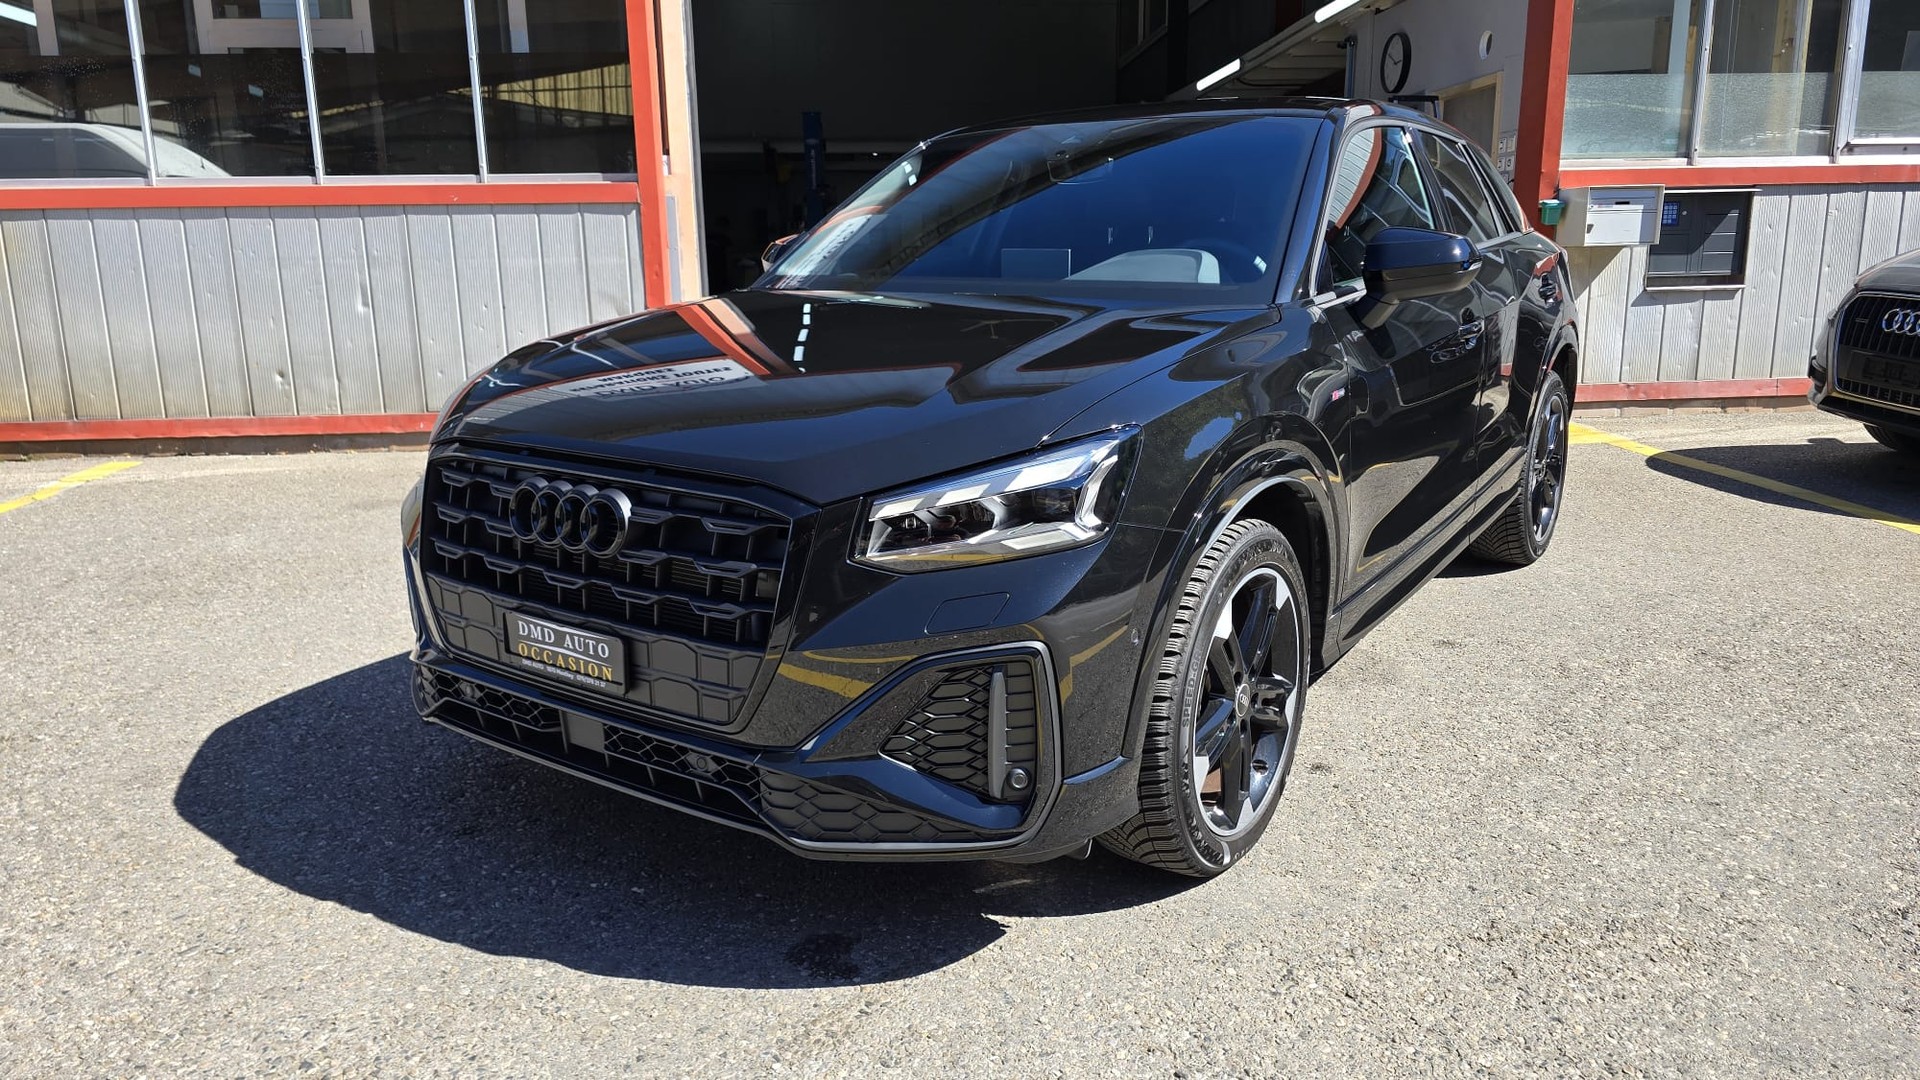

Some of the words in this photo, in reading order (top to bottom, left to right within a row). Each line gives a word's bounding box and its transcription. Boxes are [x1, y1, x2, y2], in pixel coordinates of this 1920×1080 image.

[518, 621, 555, 643] DMD
[563, 634, 609, 658] AUTO
[518, 643, 612, 682] OCCASION
